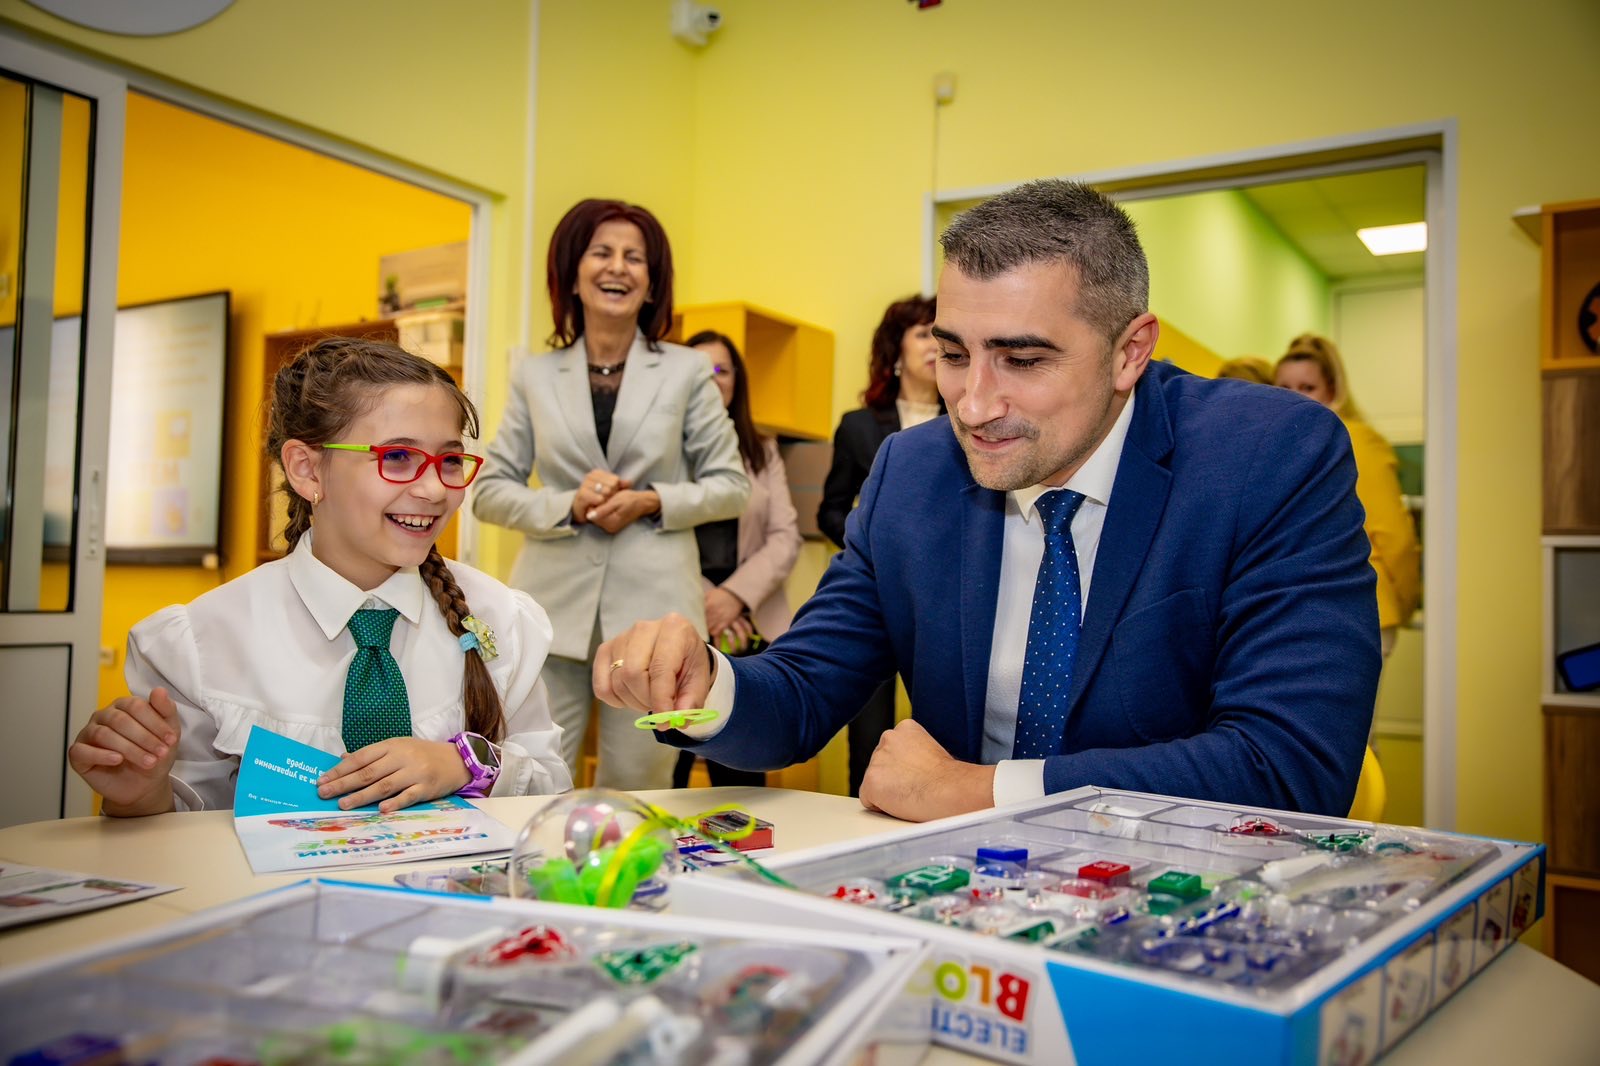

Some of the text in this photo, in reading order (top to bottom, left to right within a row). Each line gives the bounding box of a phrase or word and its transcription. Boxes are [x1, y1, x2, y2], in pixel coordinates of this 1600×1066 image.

[254, 757, 298, 779] управление
[286, 757, 318, 775] употреба
[299, 774, 308, 783] за
[296, 832, 488, 858] ЕЛЕКТРОННИ
